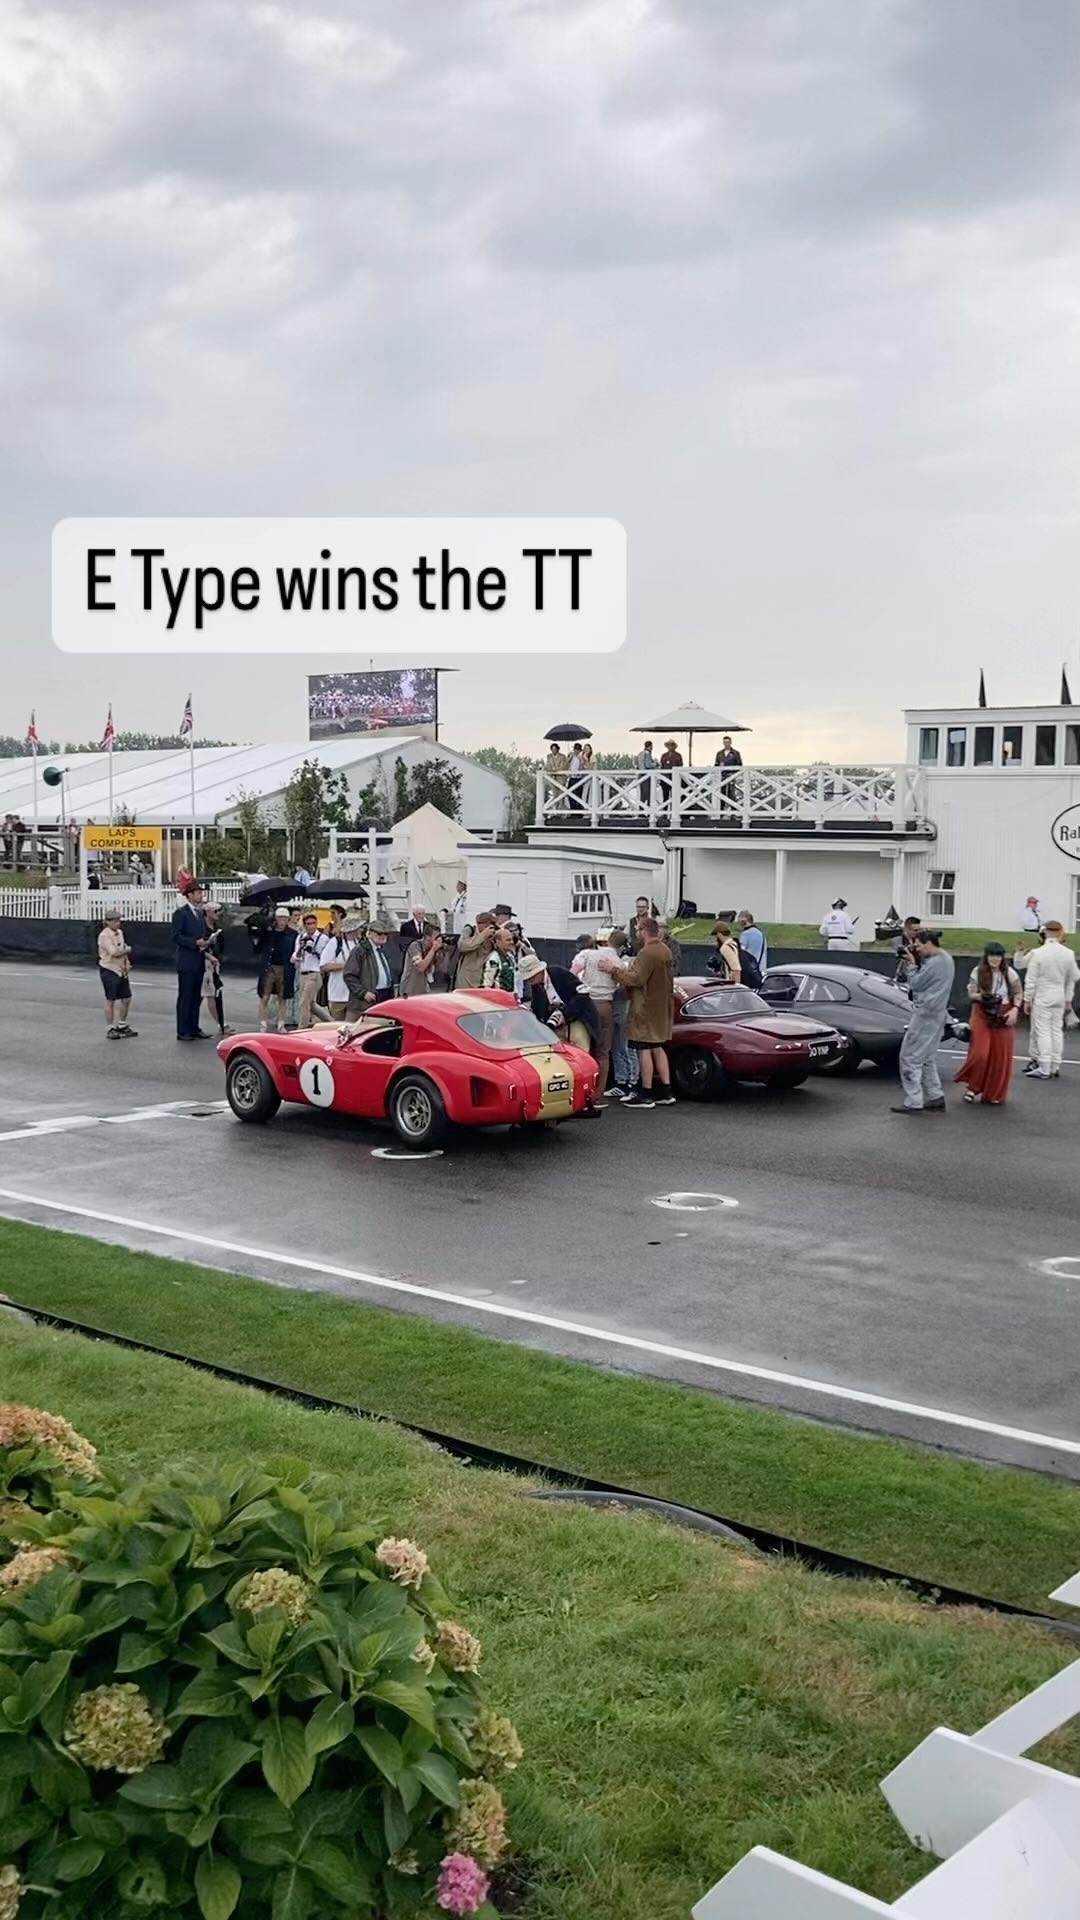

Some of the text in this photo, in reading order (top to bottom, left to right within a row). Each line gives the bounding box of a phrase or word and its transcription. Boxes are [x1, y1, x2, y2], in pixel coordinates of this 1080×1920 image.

[108, 828, 136, 837] LAPS
[90, 839, 155, 848] COMPLETED
[311, 1064, 321, 1096] 1
